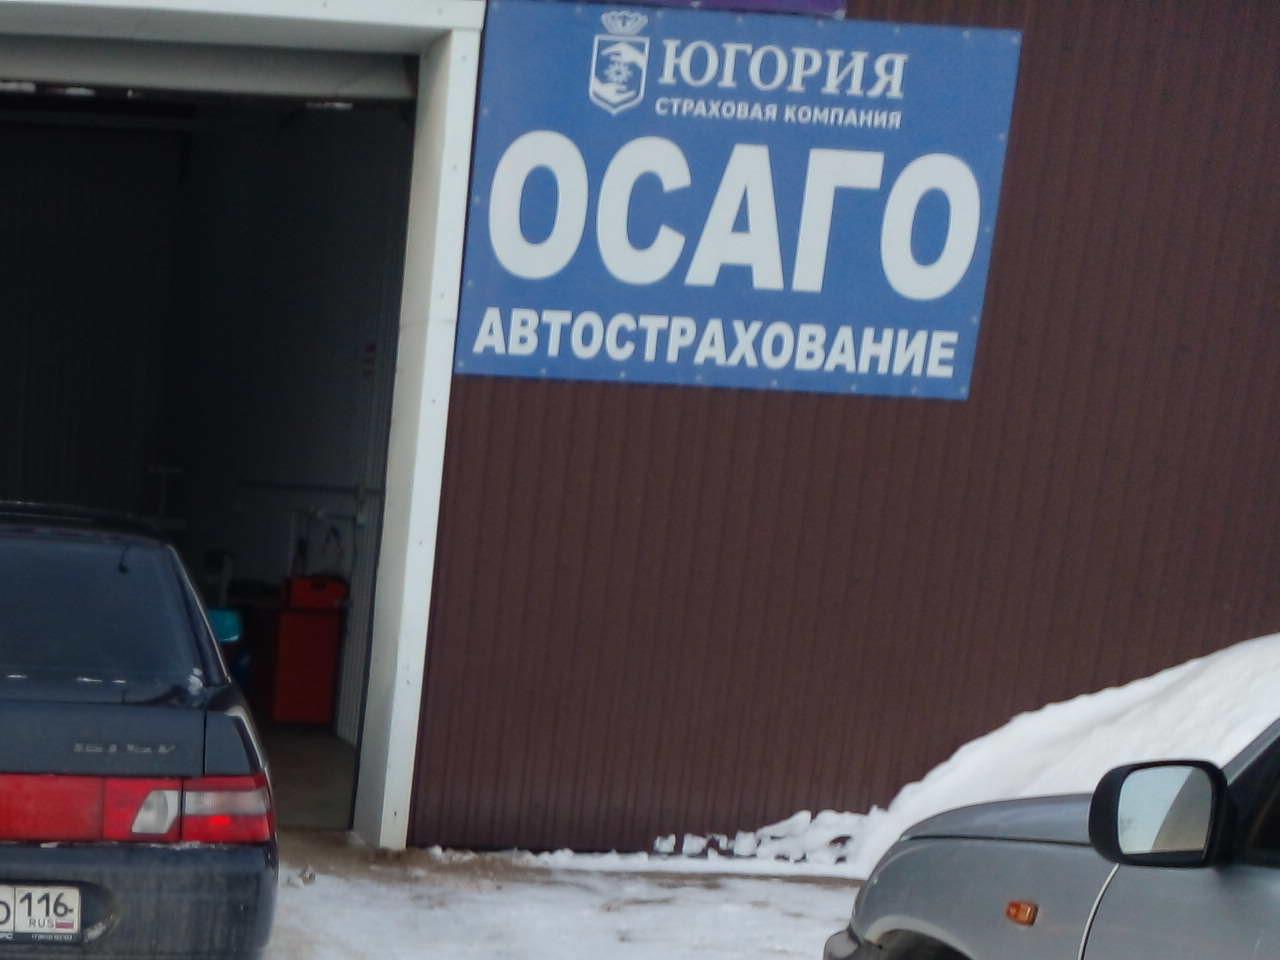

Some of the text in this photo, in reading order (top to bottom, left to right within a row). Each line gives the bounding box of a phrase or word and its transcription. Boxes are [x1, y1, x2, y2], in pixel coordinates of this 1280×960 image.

[658, 39, 908, 99] ЮГОРИЯ
[655, 97, 902, 129] СТРАХОВАЯ КОМПАНИЯ
[488, 130, 981, 300] ОСАГО
[473, 307, 959, 379] АВТОСТРАХОВАНИЕ
[20, 892, 67, 918] 116
[29, 919, 54, 928] RUS
